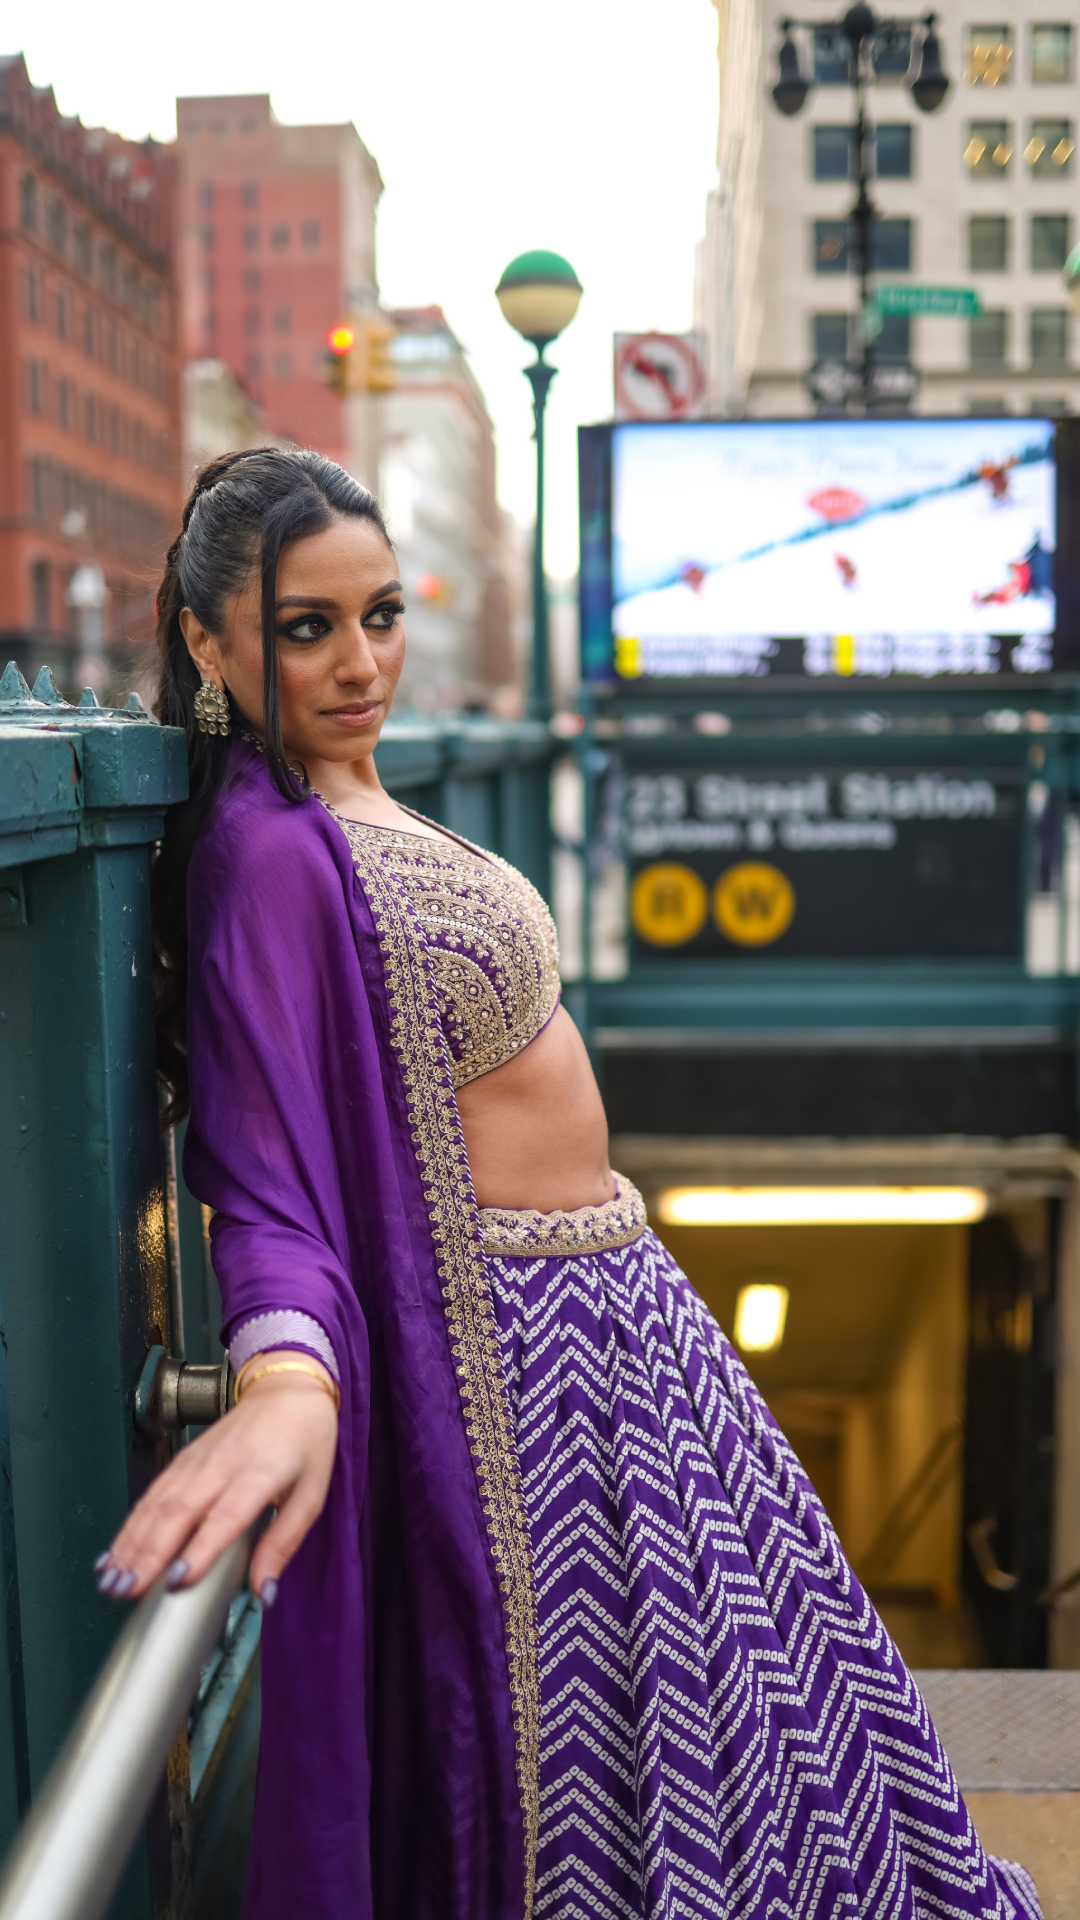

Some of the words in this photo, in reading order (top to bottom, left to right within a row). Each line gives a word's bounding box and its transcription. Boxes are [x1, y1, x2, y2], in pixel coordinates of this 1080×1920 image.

[631, 775, 686, 816] 23
[698, 774, 829, 817] Street
[843, 773, 996, 818] Station
[730, 884, 781, 921] W
